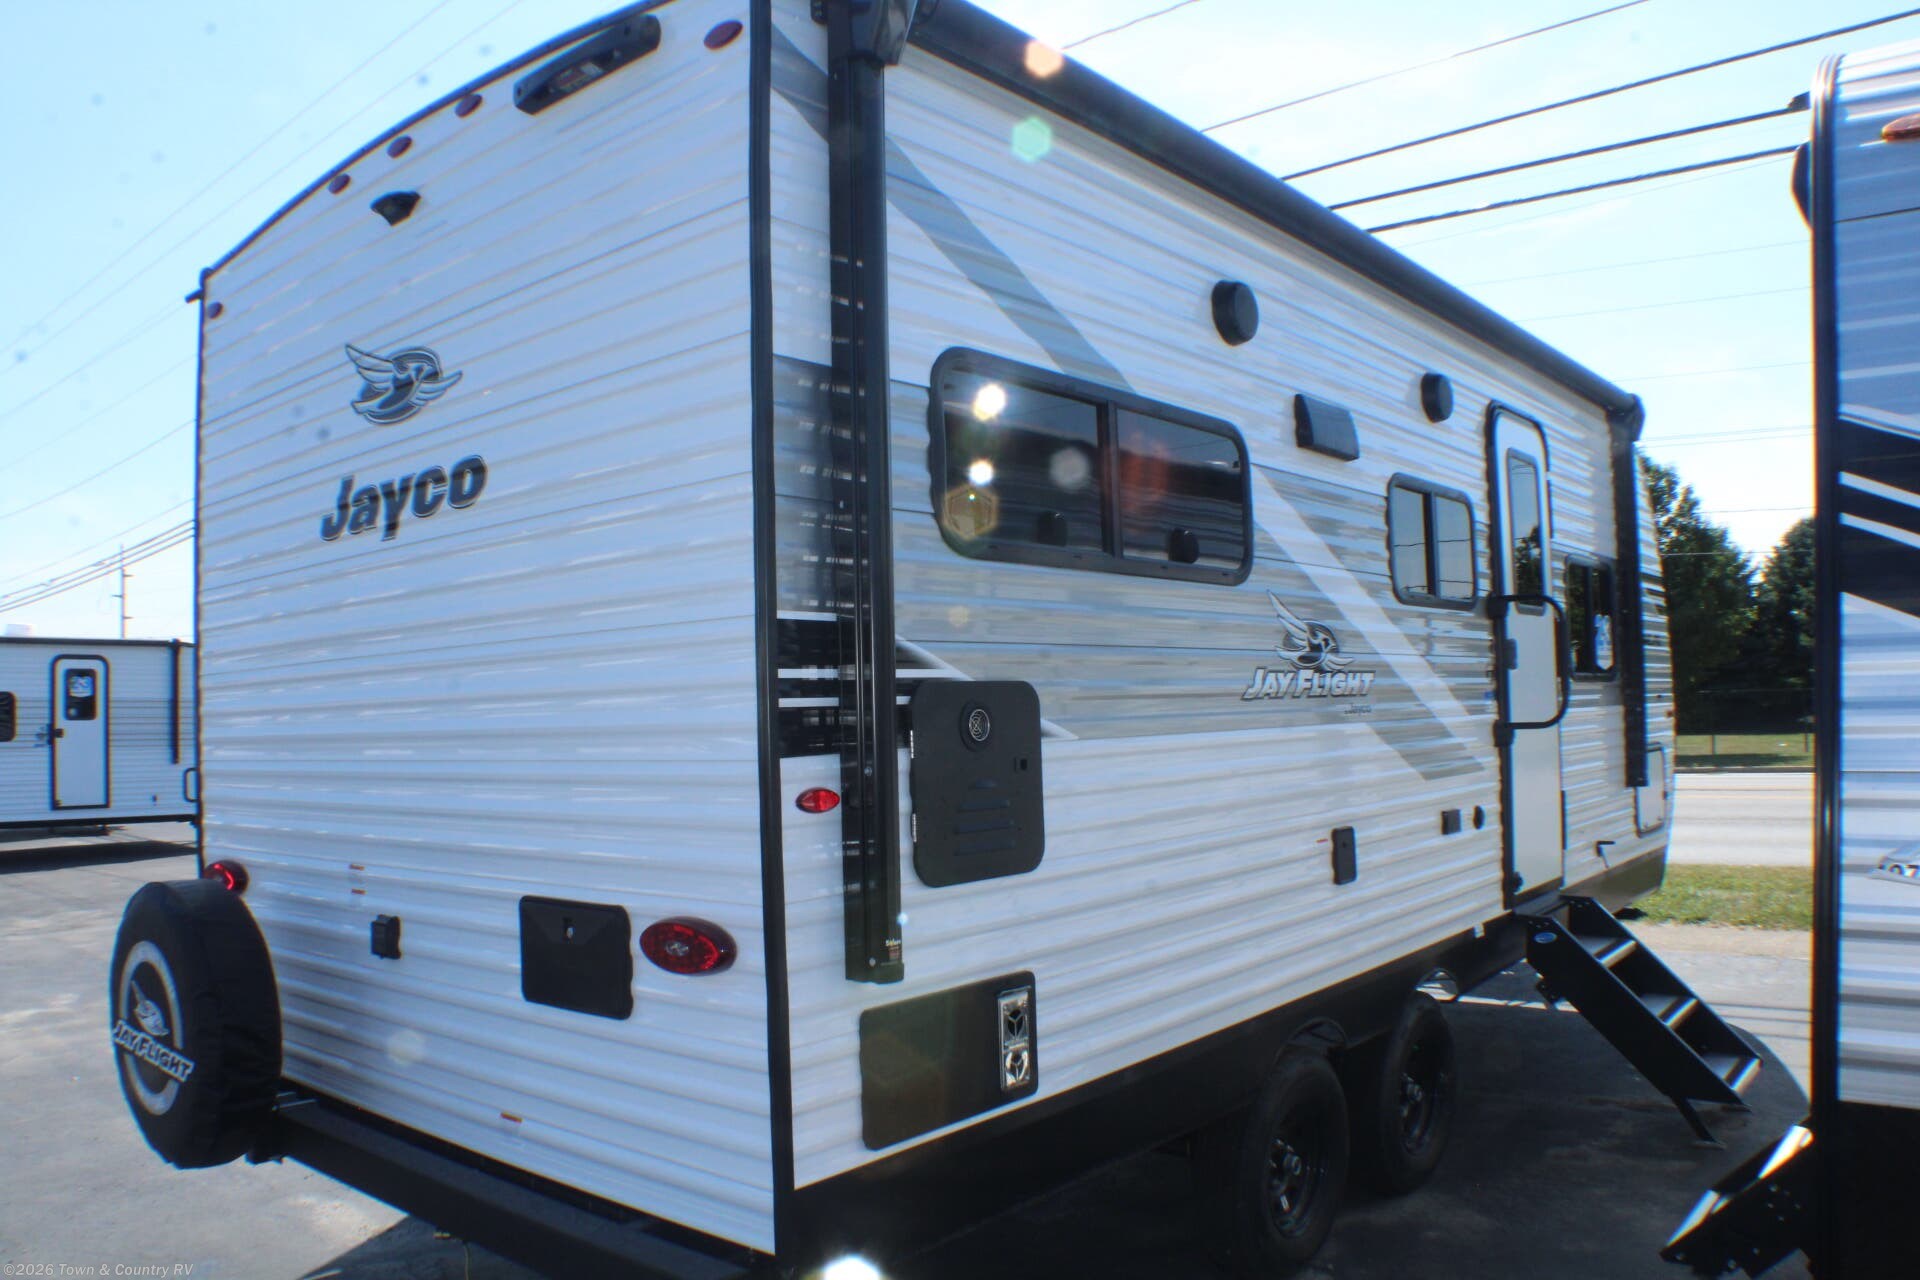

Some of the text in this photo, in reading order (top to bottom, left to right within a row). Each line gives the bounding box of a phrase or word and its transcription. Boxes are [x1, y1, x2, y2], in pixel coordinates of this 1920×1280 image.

[320, 455, 486, 541] Jayco
[1242, 667, 1375, 700] JAY FLIGHT
[113, 1021, 191, 1078] JAY FLIGHT
